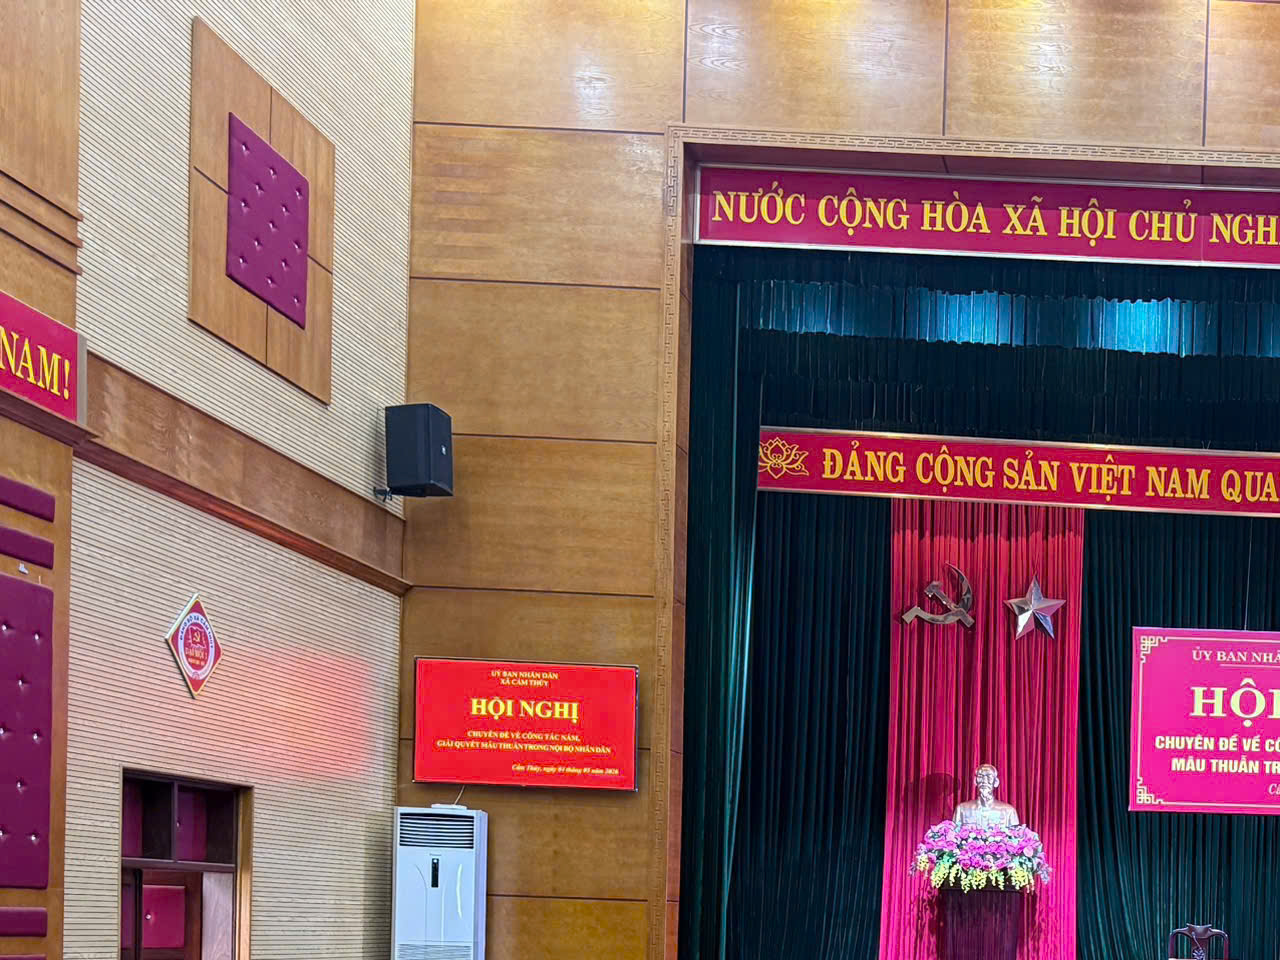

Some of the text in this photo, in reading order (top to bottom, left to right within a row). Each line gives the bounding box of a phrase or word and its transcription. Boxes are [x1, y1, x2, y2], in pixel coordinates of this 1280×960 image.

[711, 181, 806, 225] NƯỚC
[817, 187, 908, 236] CỘNG
[920, 191, 990, 233] HÒA
[1002, 196, 1047, 237] XÃ
[1058, 198, 1116, 247] HỘI
[1128, 198, 1197, 243] CHỦ
[822, 440, 906, 484] ĐẢNG
[915, 445, 995, 493] CỘNG
[1003, 450, 1060, 491] SẢN
[1069, 454, 1135, 502] VIỆT
[1146, 466, 1211, 499] NAM
[1192, 646, 1212, 661] ỦY
[1217, 650, 1247, 662] BAN
[471, 696, 580, 724] HỘI NGHỊ
[1155, 734, 1215, 750] CHUYÊN
[1218, 734, 1239, 751] ĐỀ
[1242, 735, 1261, 752] VỀ
[1171, 755, 1206, 772] MÂU
[1210, 755, 1260, 774] THUẪN
